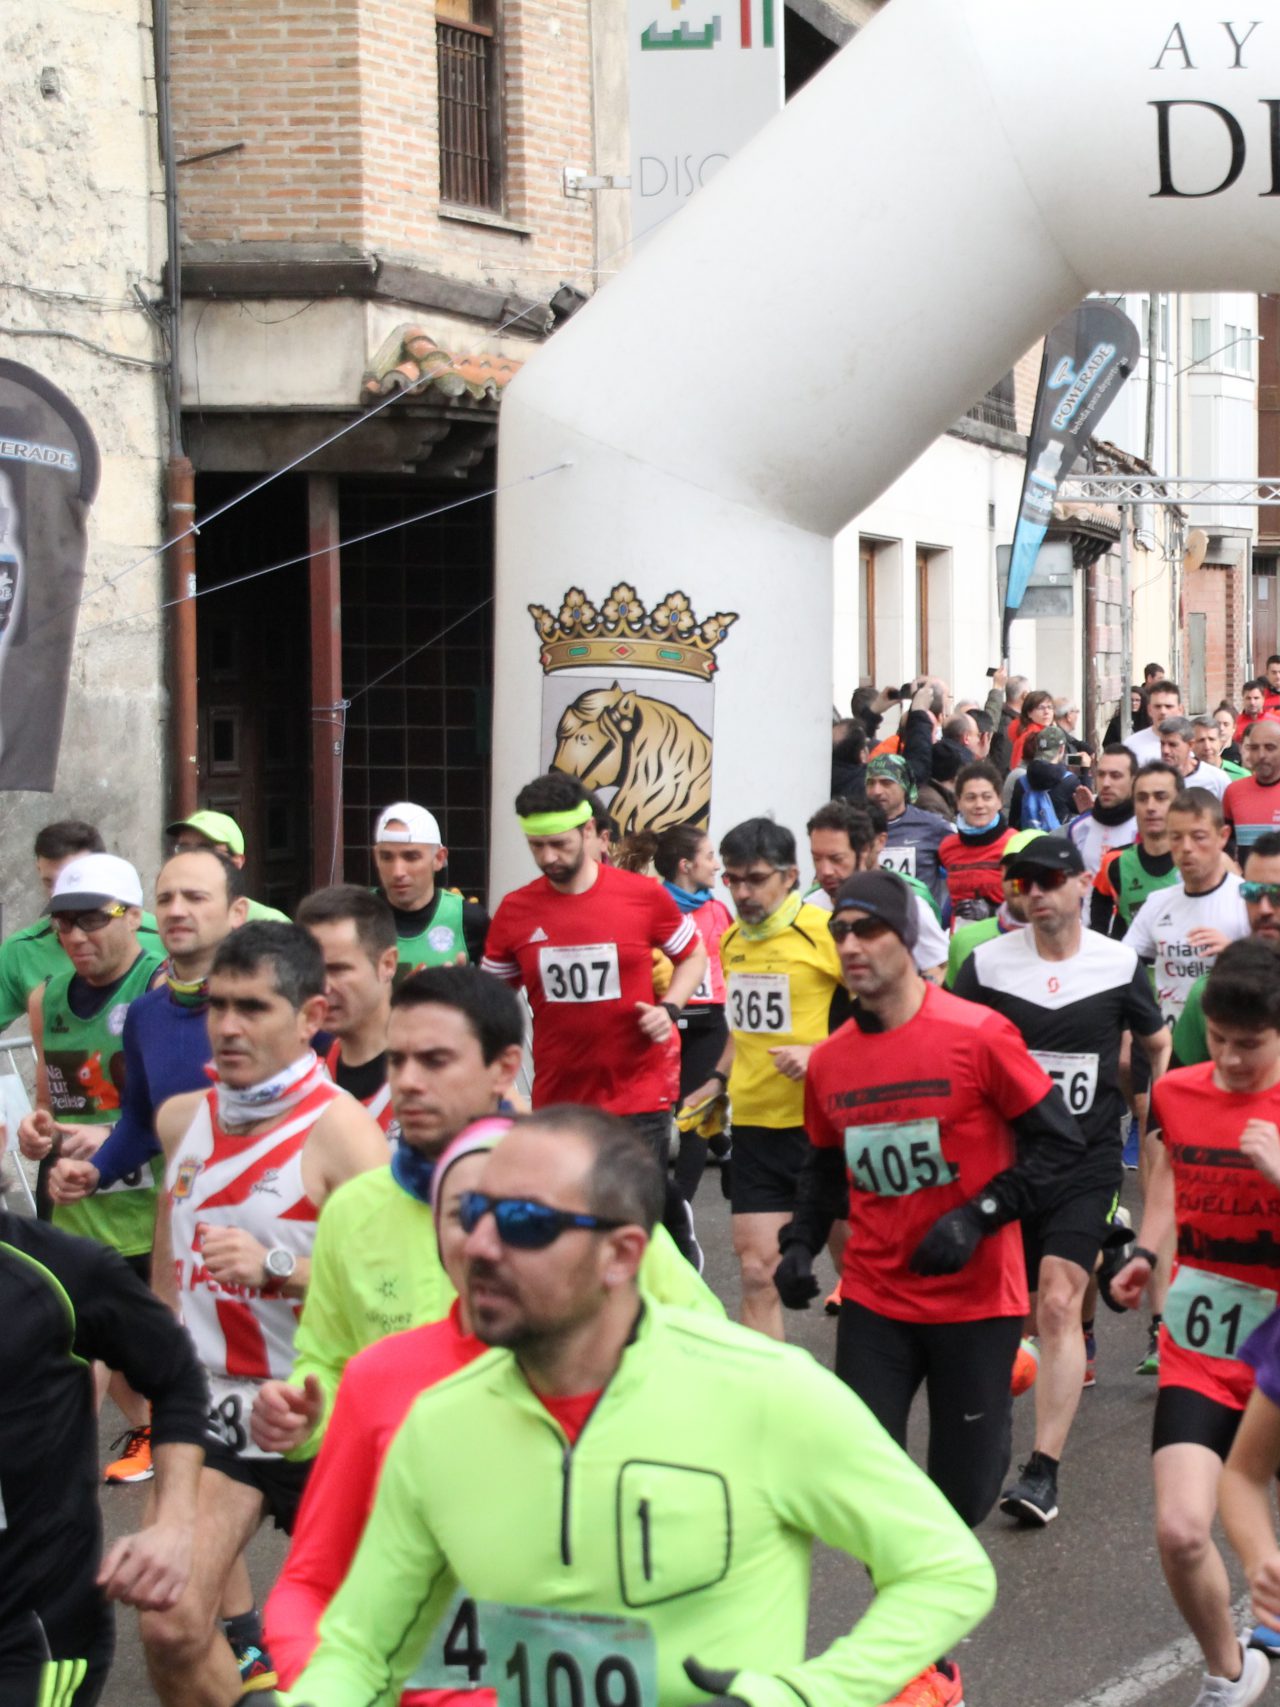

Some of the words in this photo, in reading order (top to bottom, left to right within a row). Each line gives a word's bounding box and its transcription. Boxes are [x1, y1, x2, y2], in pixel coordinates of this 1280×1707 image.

[0, 437, 71, 467] ERADE
[547, 961, 611, 999] 307
[732, 990, 784, 1030] 365
[857, 1141, 939, 1193] 105
[1186, 1295, 1243, 1355] 61
[506, 1641, 642, 1707] 109
